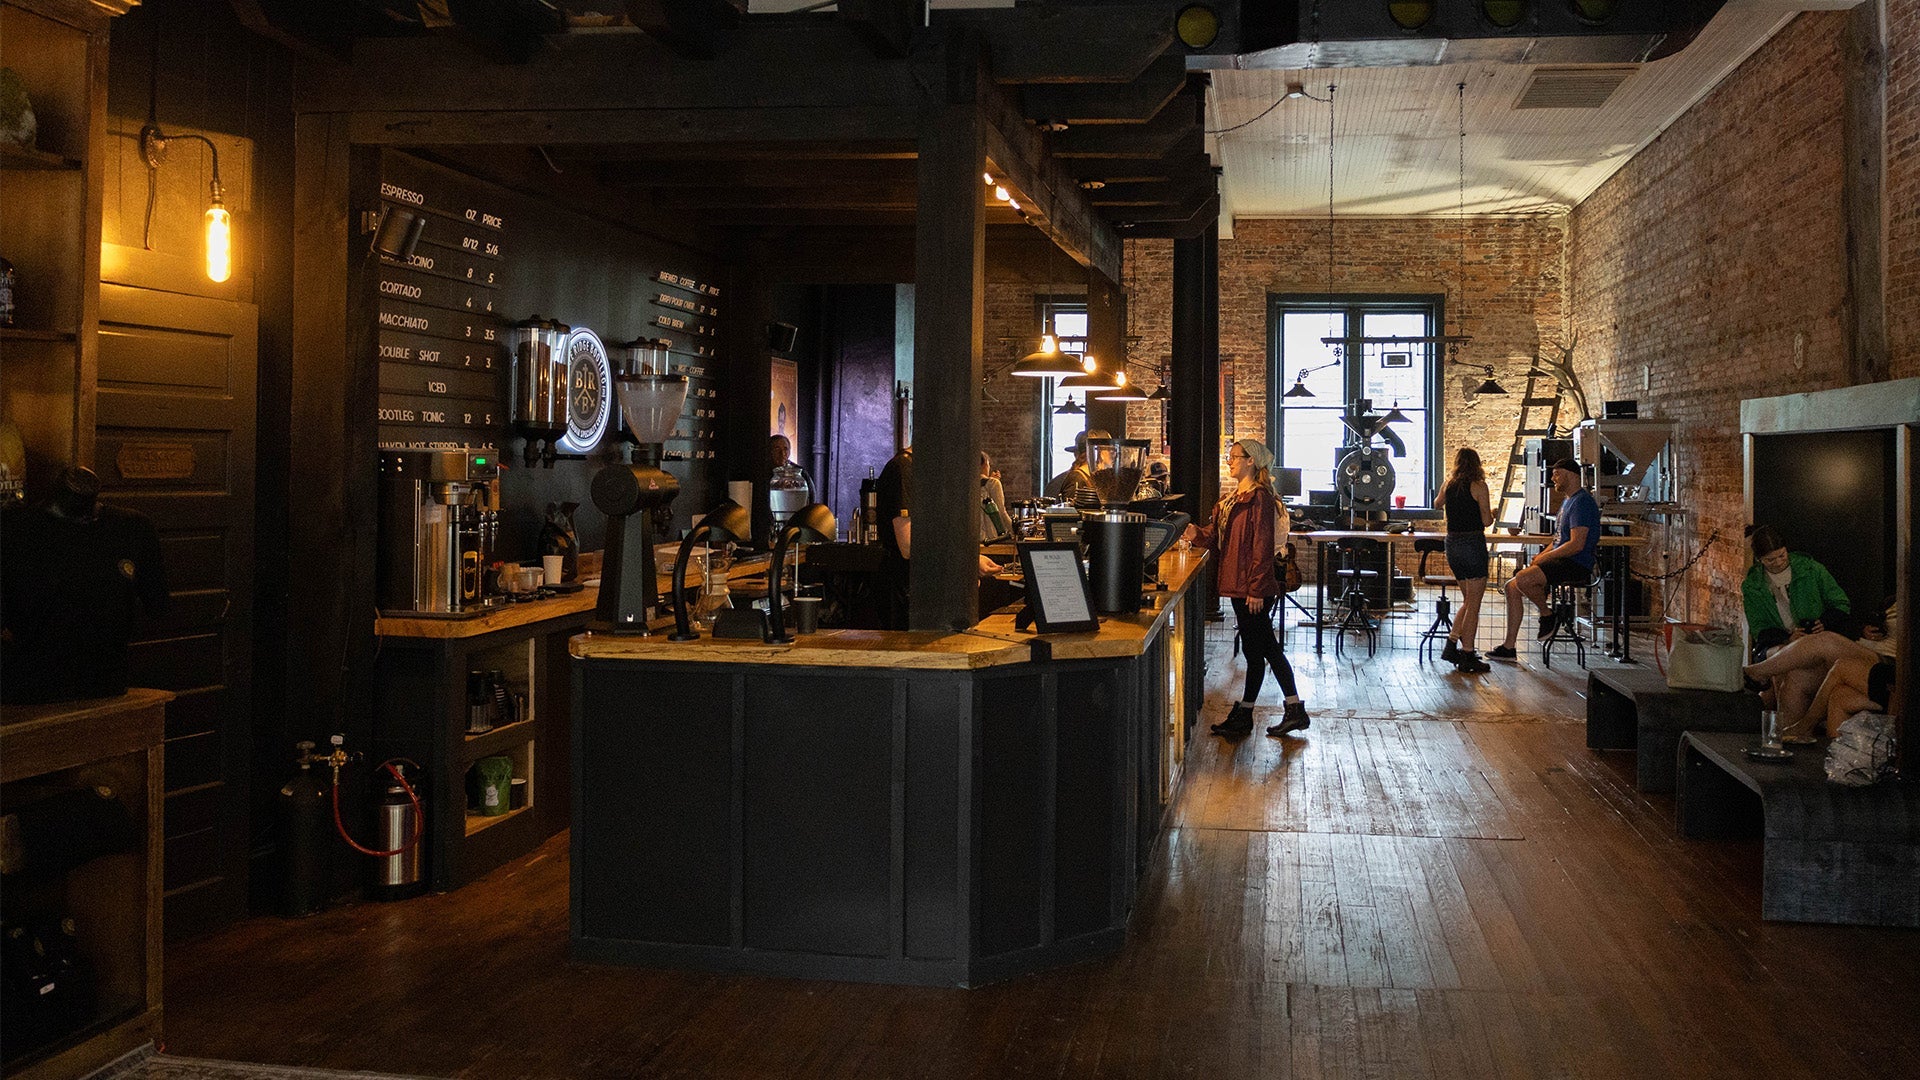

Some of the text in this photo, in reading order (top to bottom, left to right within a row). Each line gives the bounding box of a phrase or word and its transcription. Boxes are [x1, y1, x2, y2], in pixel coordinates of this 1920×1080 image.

[380, 183, 424, 205] ESPRESSO
[466, 209, 503, 229] OZ PRICE
[462, 237, 499, 255] 8/12 5/6
[466, 268, 473, 279] 8
[488, 273, 495, 284] 5
[379, 281, 493, 312] CORTADO 4 4
[378, 312, 429, 331] MACCHIATO
[465, 326, 472, 337] 3
[379, 345, 492, 369] DOUBLE SHOT 2 3
[428, 381, 447, 394] ICED
[575, 370, 596, 390] B R
[581, 396, 589, 414] B
[378, 408, 491, 425] BOOTLEG TONIC 12 5
